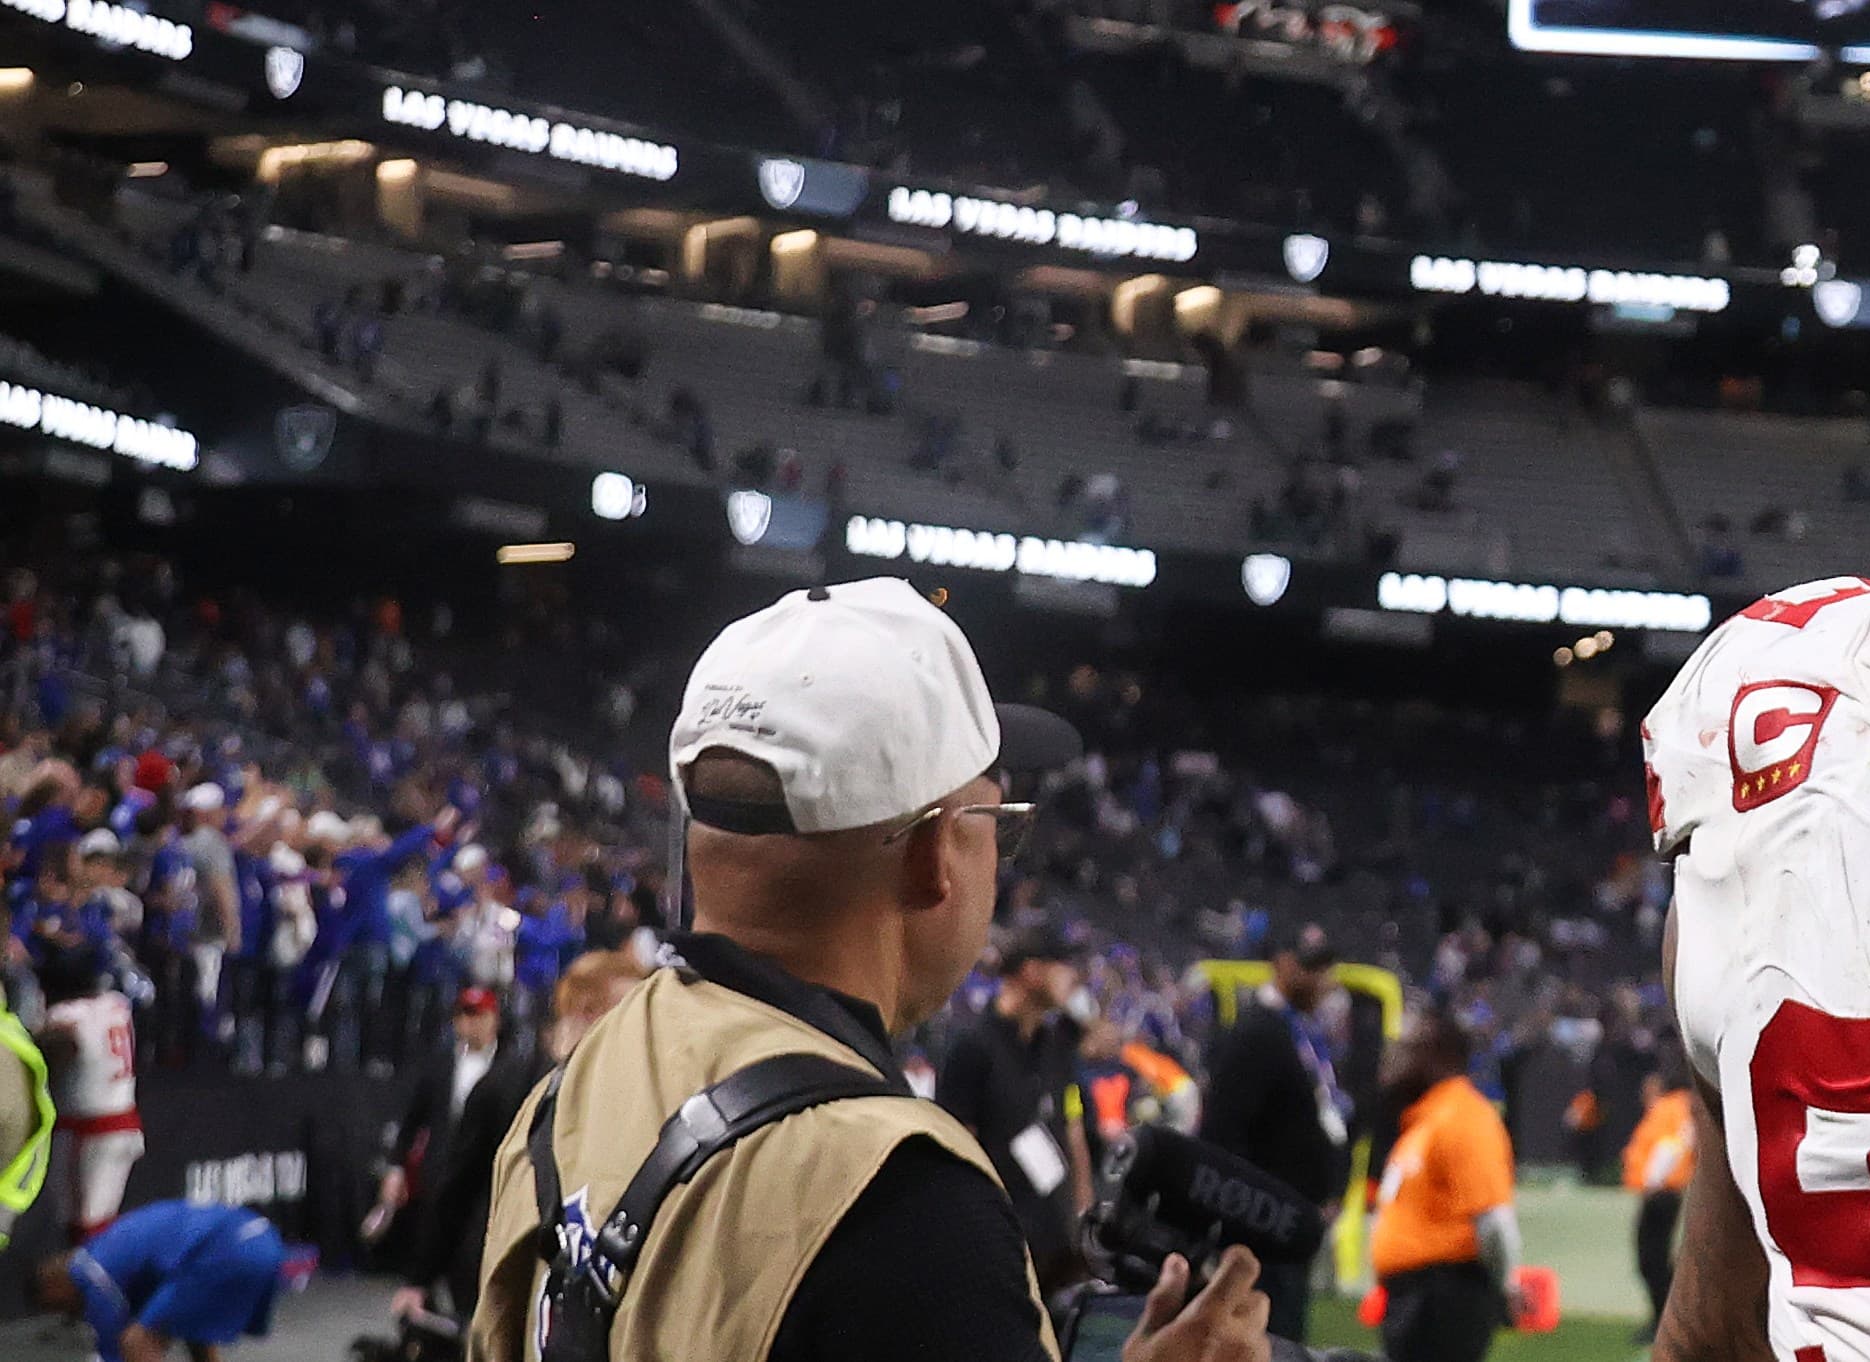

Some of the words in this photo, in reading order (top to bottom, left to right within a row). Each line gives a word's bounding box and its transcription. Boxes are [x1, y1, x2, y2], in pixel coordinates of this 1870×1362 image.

[382, 87, 446, 130] LAS
[447, 101, 550, 153] VEGAS
[550, 123, 678, 181] RAIDERS
[889, 186, 953, 227] LAS
[953, 197, 1057, 244] VEGAS
[1056, 214, 1197, 261] RAIDERS
[1411, 256, 1476, 293] LAS
[1477, 261, 1588, 301] VEGAS
[1588, 269, 1730, 312] RAIDERS
[41, 394, 116, 449] VEGAS
[113, 414, 196, 471] RAIDERS
[846, 515, 905, 559] LAS
[906, 524, 1016, 571] VEGAS
[1016, 536, 1157, 587] RAIDERS
[1378, 572, 1447, 613] LAS
[1448, 578, 1559, 622] VEGAS
[1559, 588, 1711, 632] RAIDERS
[1734, 686, 1823, 774] C
